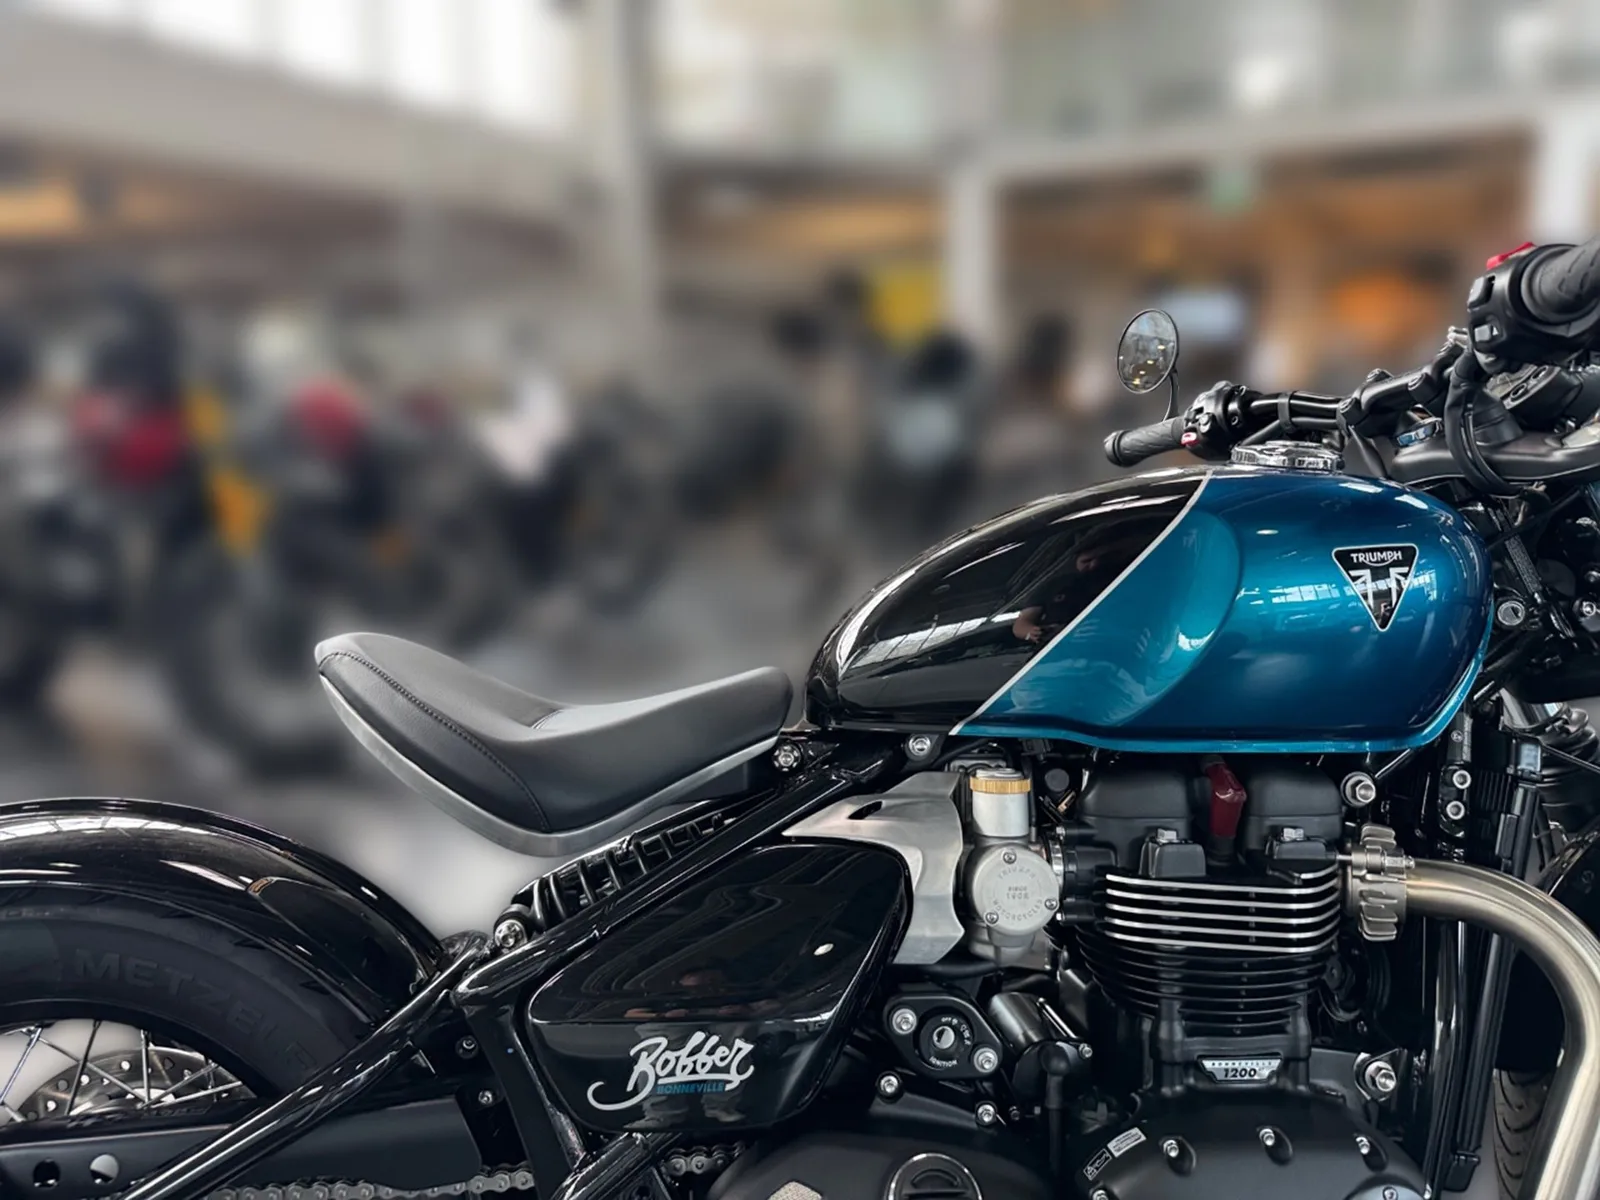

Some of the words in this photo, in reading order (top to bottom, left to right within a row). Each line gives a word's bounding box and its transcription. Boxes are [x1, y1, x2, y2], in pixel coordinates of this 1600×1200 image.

[1350, 550, 1402, 566] TRIUMPH
[587, 1031, 755, 1110] Bobber
[1223, 1068, 1257, 1078] 1200
[656, 1082, 725, 1094] BONNEVILLE
